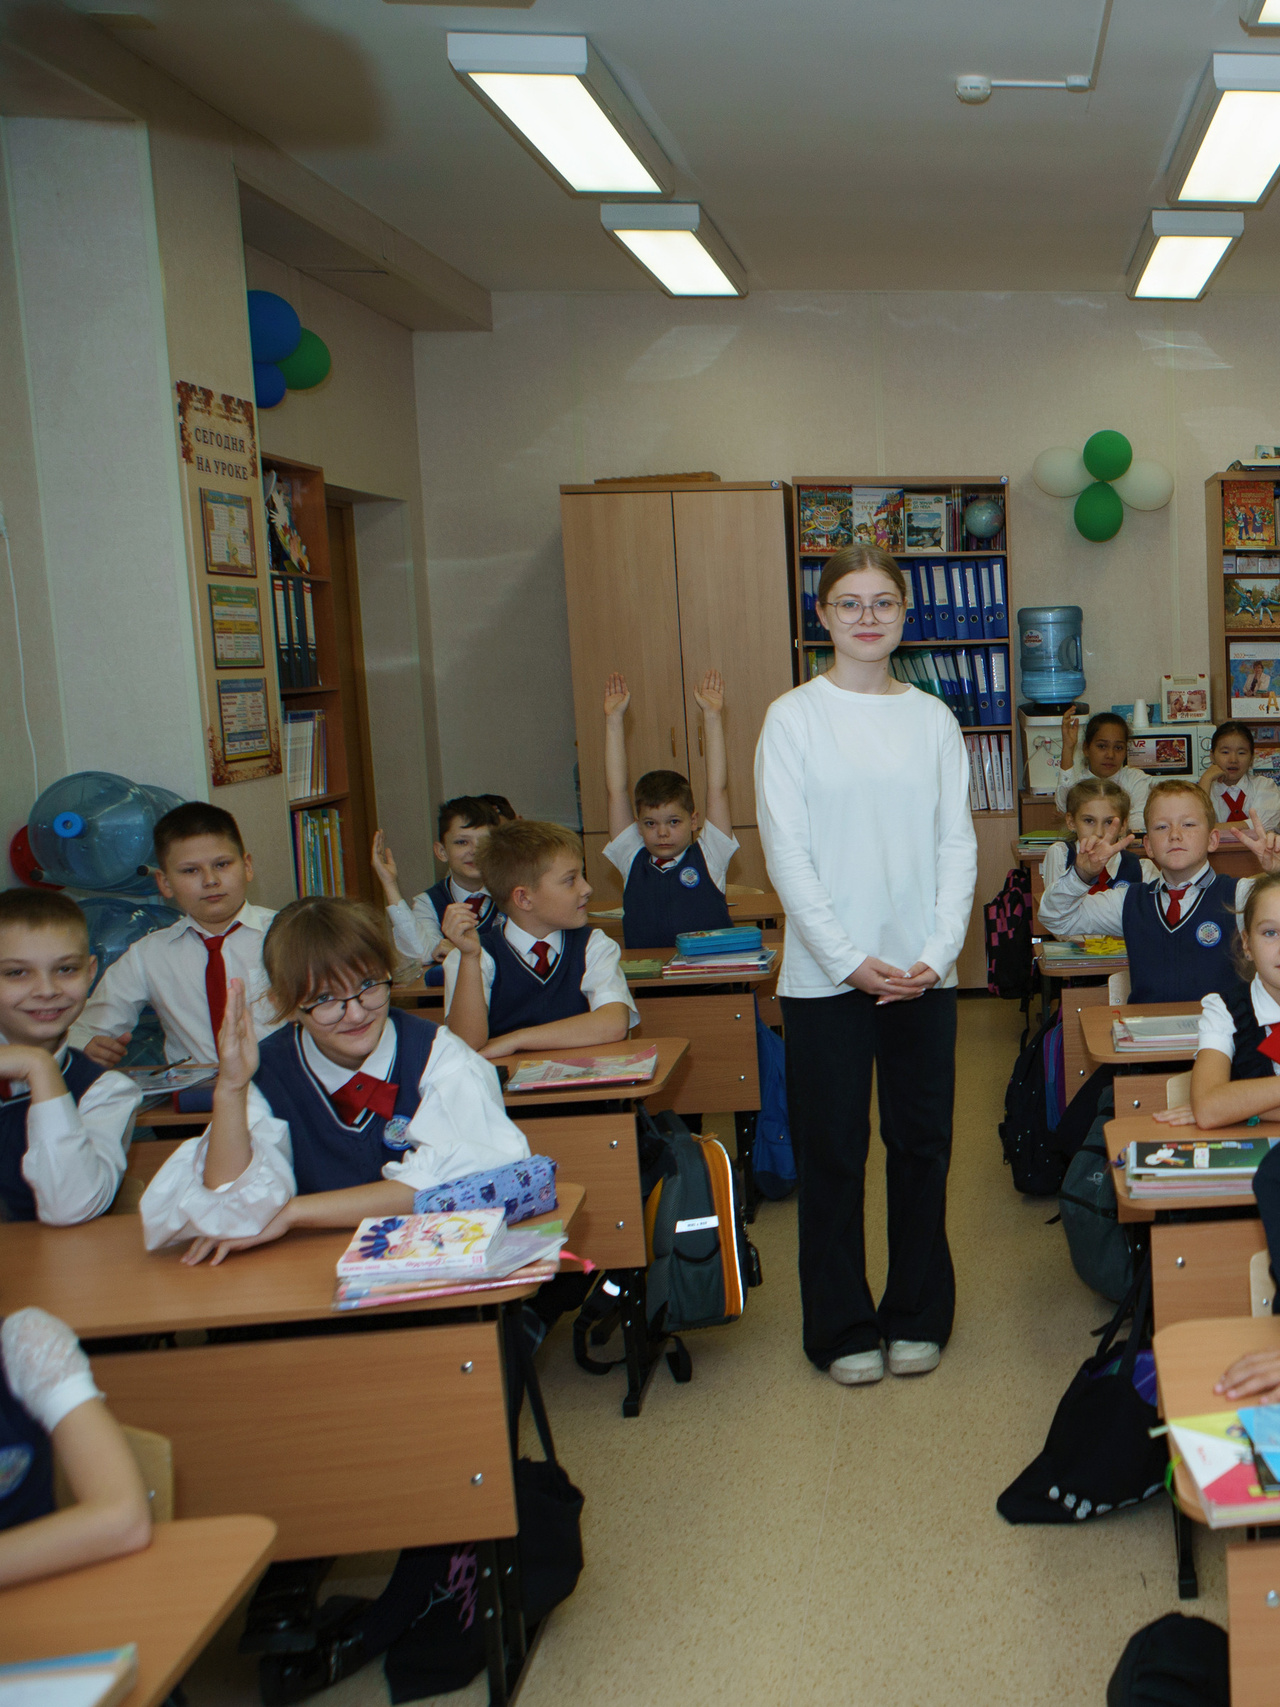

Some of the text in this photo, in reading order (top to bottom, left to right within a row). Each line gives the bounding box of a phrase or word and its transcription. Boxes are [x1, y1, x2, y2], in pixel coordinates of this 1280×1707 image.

[195, 427, 246, 453] СЕГОДНЯ
[196, 456, 248, 481] НА УРОКЕ
